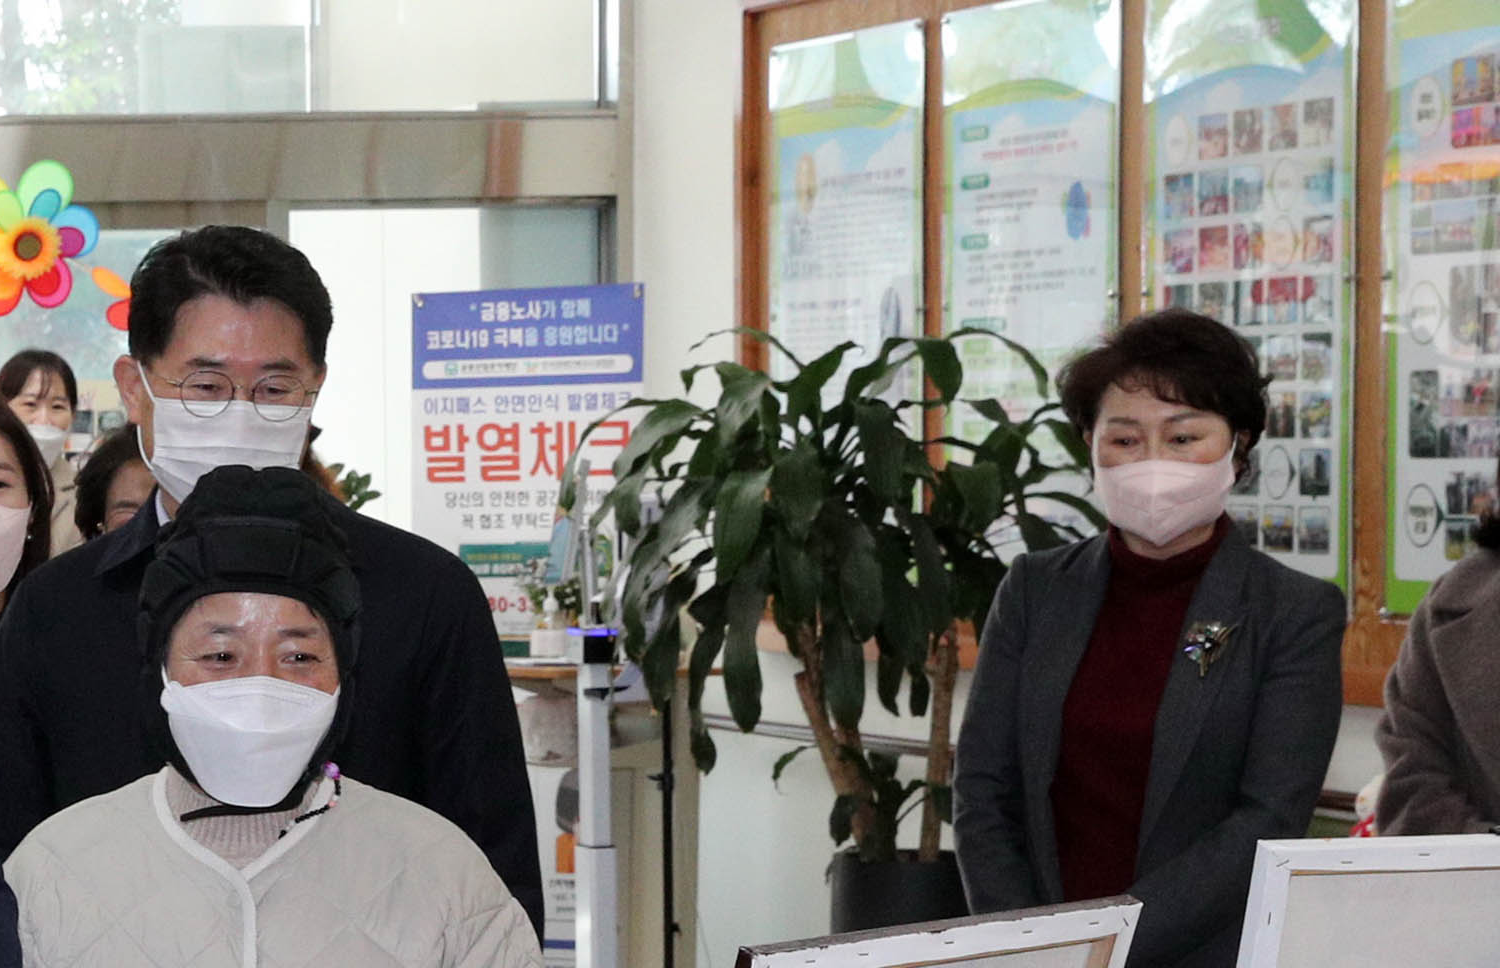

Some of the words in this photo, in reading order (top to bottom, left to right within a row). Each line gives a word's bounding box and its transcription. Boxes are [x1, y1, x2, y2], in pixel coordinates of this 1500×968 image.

[480, 300, 557, 322] 금융노사가
[426, 329, 489, 350] 코로나19
[493, 327, 539, 348] 극복을
[544, 323, 619, 347] 응원합니다
[423, 396, 486, 416] 이지패스
[493, 394, 559, 414] 안면인식
[423, 420, 631, 483] 발열체크
[444, 490, 484, 508] 당신의
[489, 490, 530, 508] 안전한
[479, 513, 506, 530] 협조
